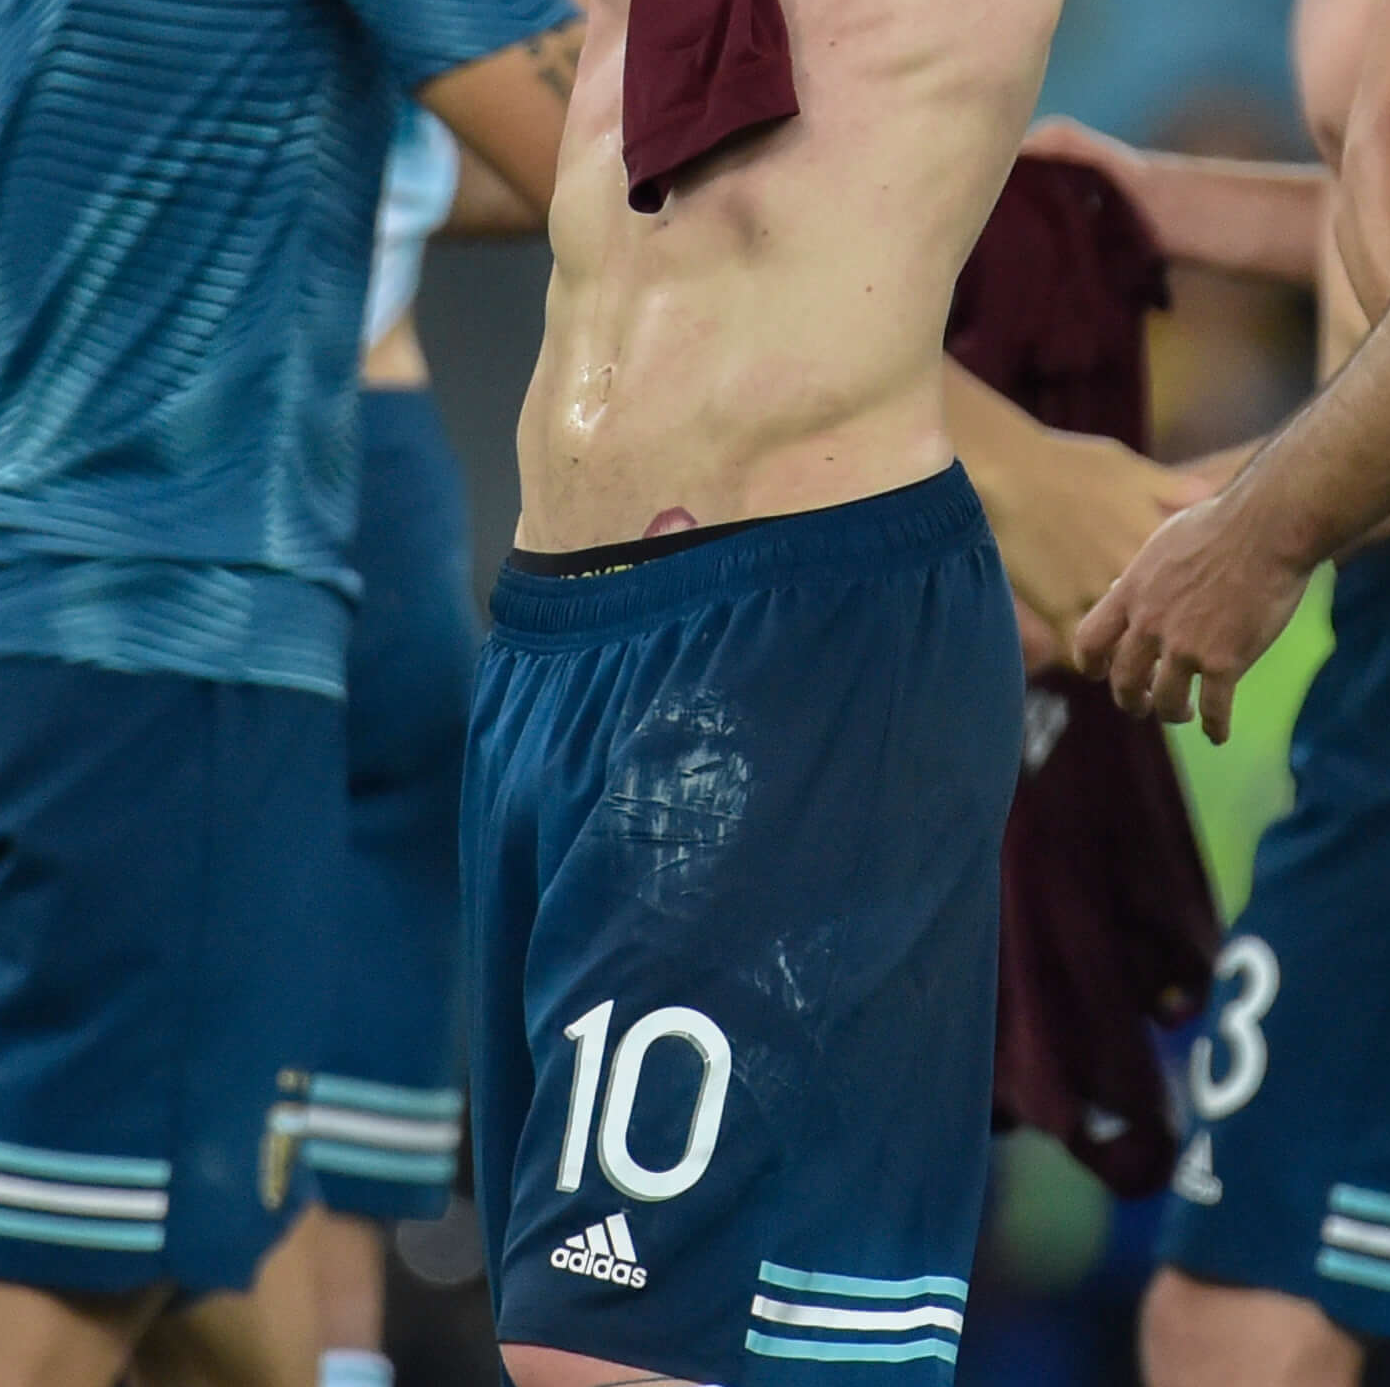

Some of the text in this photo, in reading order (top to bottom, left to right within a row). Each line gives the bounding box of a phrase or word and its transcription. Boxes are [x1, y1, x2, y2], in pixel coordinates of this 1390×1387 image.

[555, 999, 732, 1202] 10
[1189, 934, 1281, 1121] 3
[550, 1244, 649, 1290] adidas
